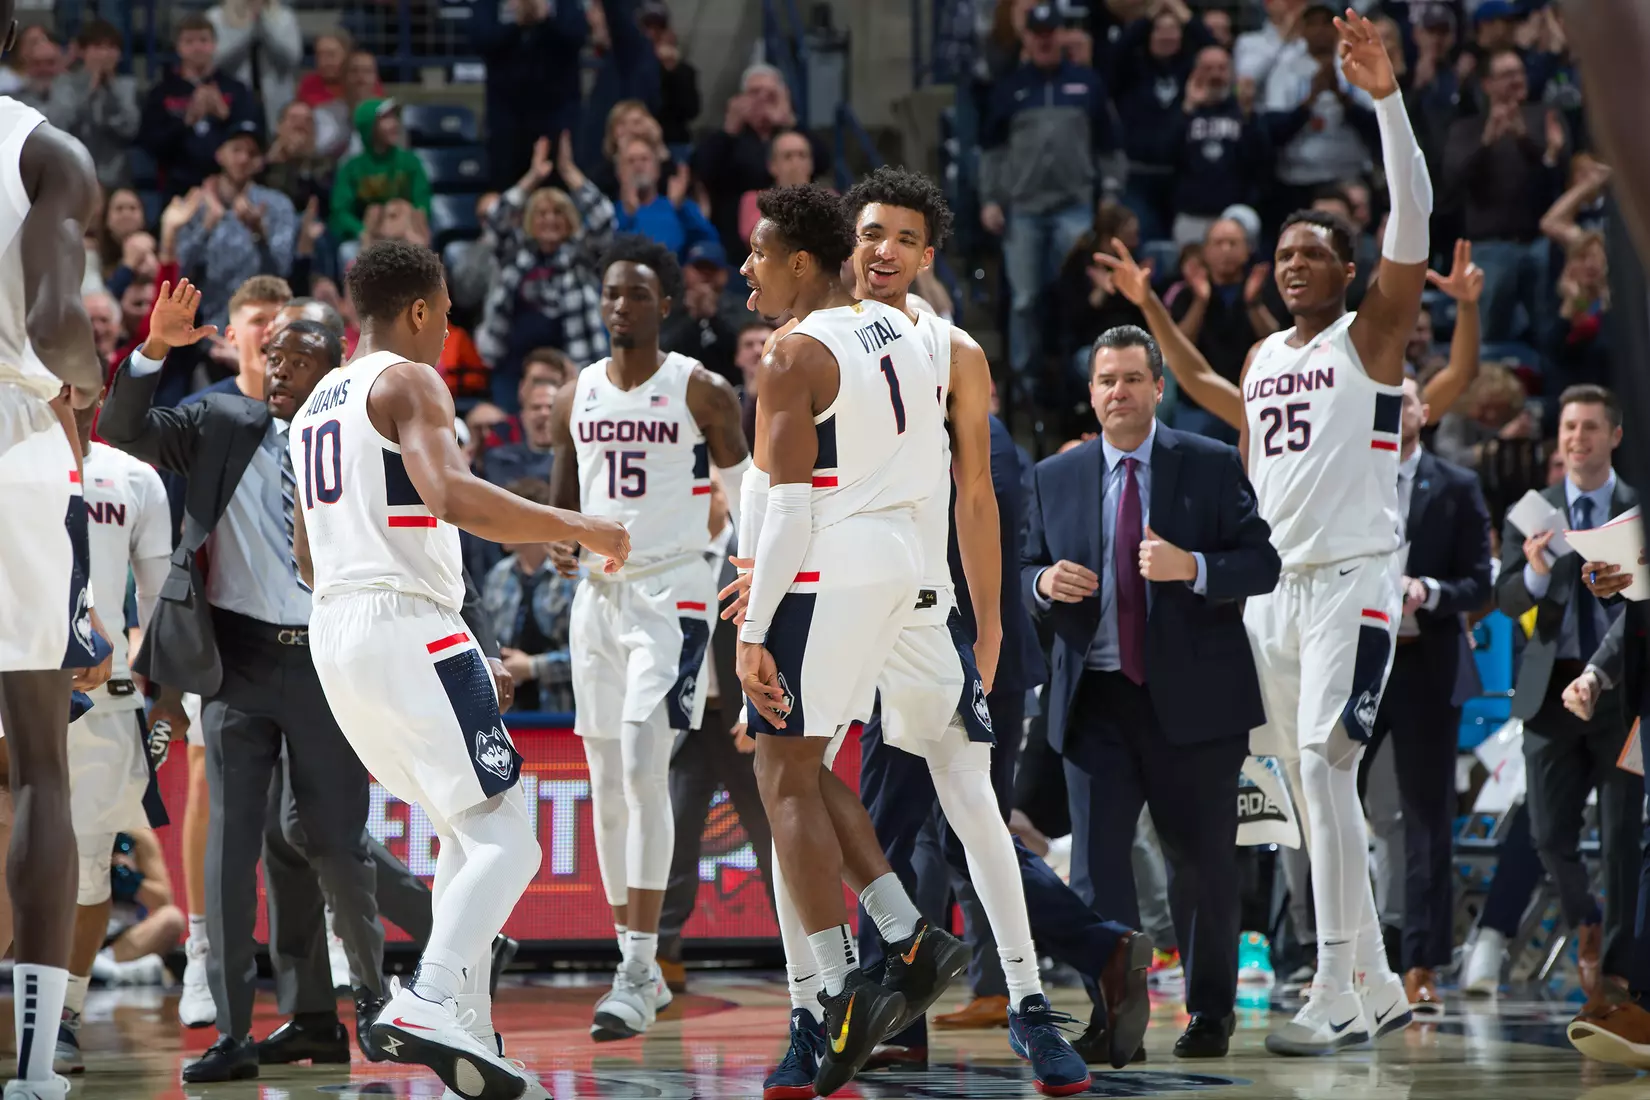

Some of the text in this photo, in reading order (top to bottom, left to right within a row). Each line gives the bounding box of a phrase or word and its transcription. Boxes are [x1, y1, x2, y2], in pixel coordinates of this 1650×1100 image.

[854, 316, 902, 354] VITAL
[304, 378, 351, 418] ADAMS
[879, 353, 906, 435] 1
[1247, 366, 1335, 403] UCONN
[578, 420, 679, 444] UCONN
[1260, 402, 1312, 458] 25
[301, 419, 343, 510] 10
[604, 450, 647, 499] 15
